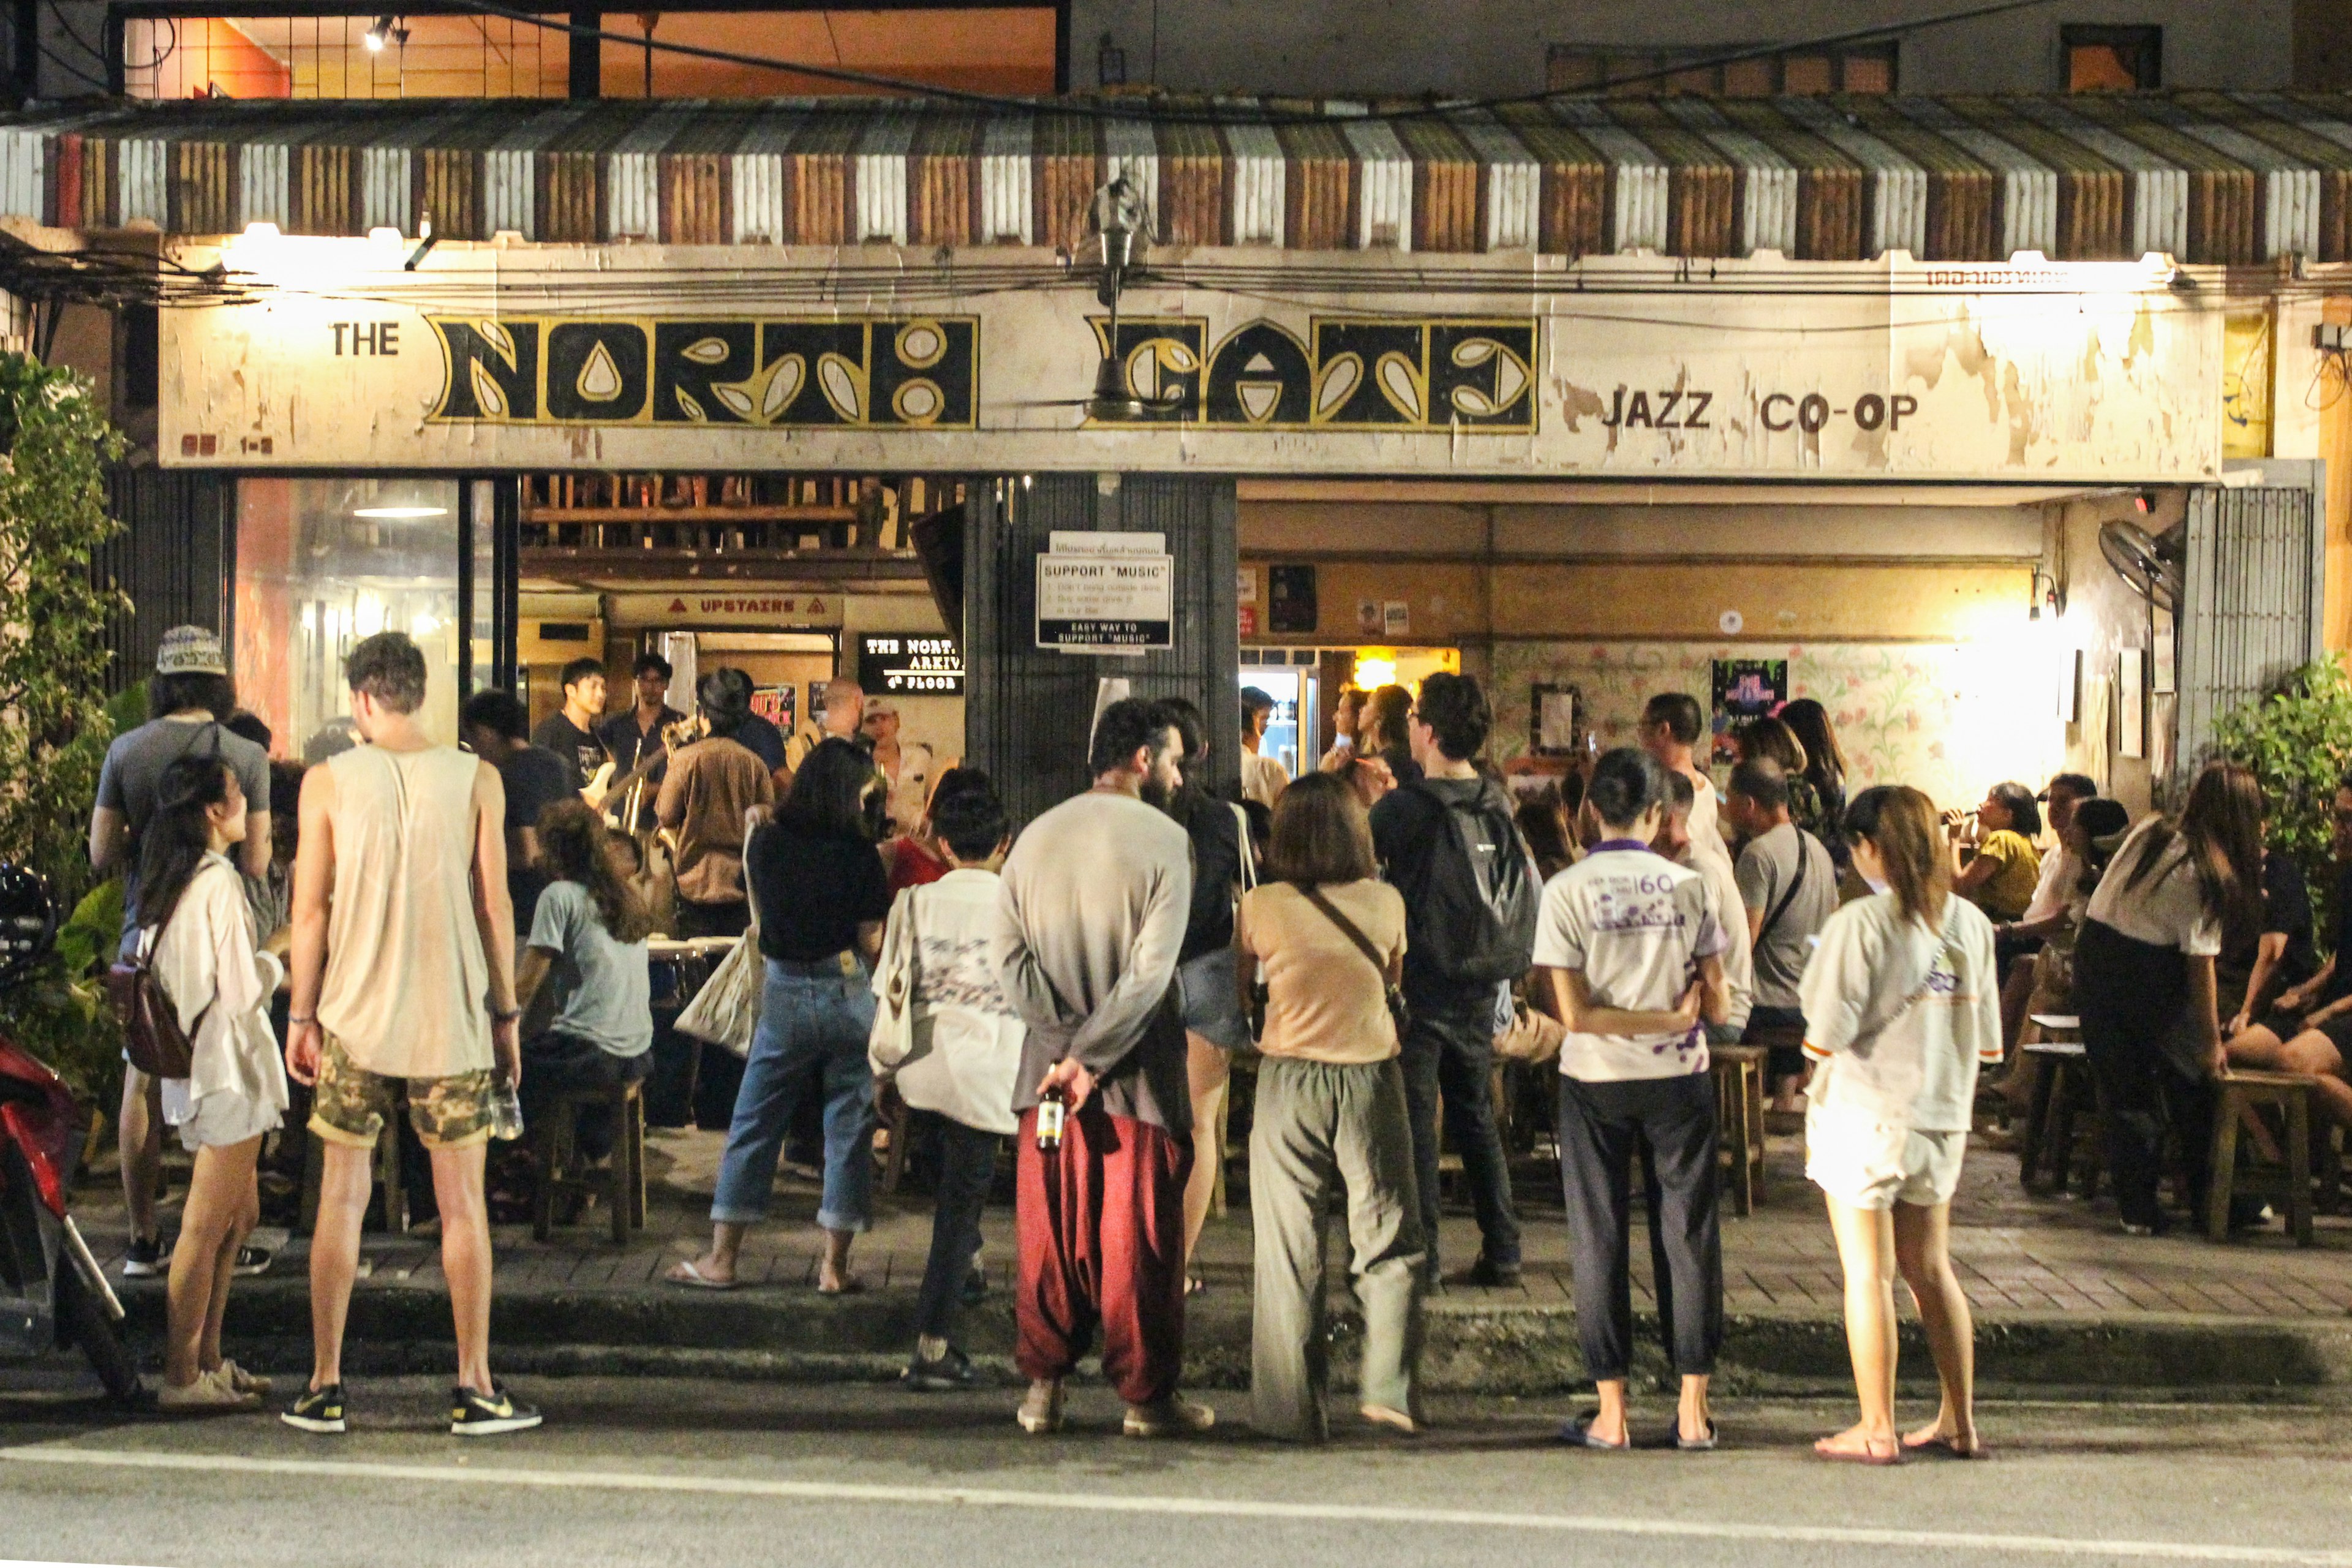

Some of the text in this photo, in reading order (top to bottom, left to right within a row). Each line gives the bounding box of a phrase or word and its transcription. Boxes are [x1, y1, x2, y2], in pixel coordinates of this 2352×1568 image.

[333, 322, 399, 356] THE
[426, 315, 979, 429] NORTH
[1602, 390, 1918, 432] JAZZ CO-OP
[1044, 565, 1104, 578] SUPPORT
[701, 599, 795, 612] UPSTAIRS
[1100, 623, 1120, 633] WAY
[1125, 623, 1137, 633] TO
[1058, 633, 1103, 643] SUPPORT
[867, 639, 957, 655] THE NORT
[909, 655, 965, 670] ARKIV
[907, 676, 956, 690] FLOOR
